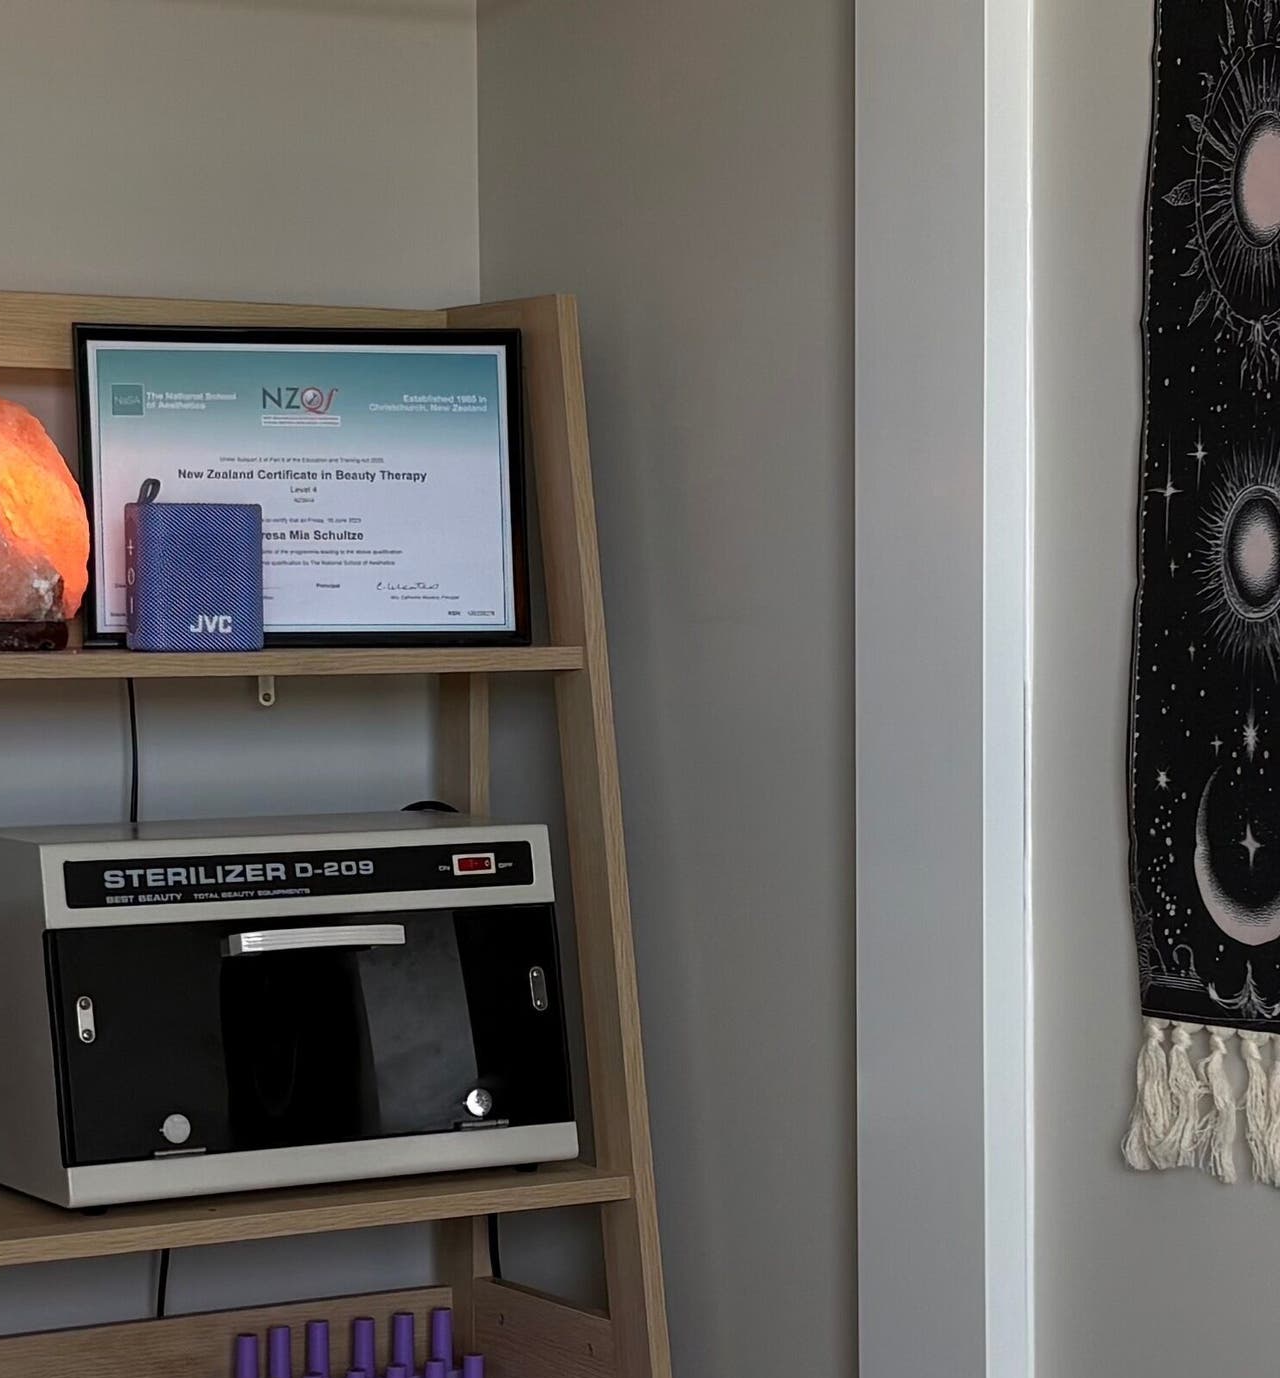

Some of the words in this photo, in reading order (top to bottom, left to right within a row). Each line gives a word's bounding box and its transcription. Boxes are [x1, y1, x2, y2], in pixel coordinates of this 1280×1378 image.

[146, 391, 164, 400] The
[177, 469, 204, 480] New
[207, 469, 254, 480] Zealand
[257, 469, 318, 481] Certificate
[321, 470, 333, 481] in
[335, 470, 376, 483] Beauty
[379, 471, 428, 483] Therapy
[290, 485, 312, 494] Level
[312, 485, 318, 494] 4
[261, 532, 287, 541] resa
[289, 530, 311, 541] Mia
[313, 530, 365, 541] Schultze
[189, 614, 233, 633] JVC
[103, 863, 287, 889] STERILIZER
[294, 860, 375, 878] D-209
[105, 895, 135, 904] BEST
[138, 892, 183, 903] BEAUTY
[193, 891, 220, 900] TOTAL
[221, 890, 255, 898] BEAUTY
